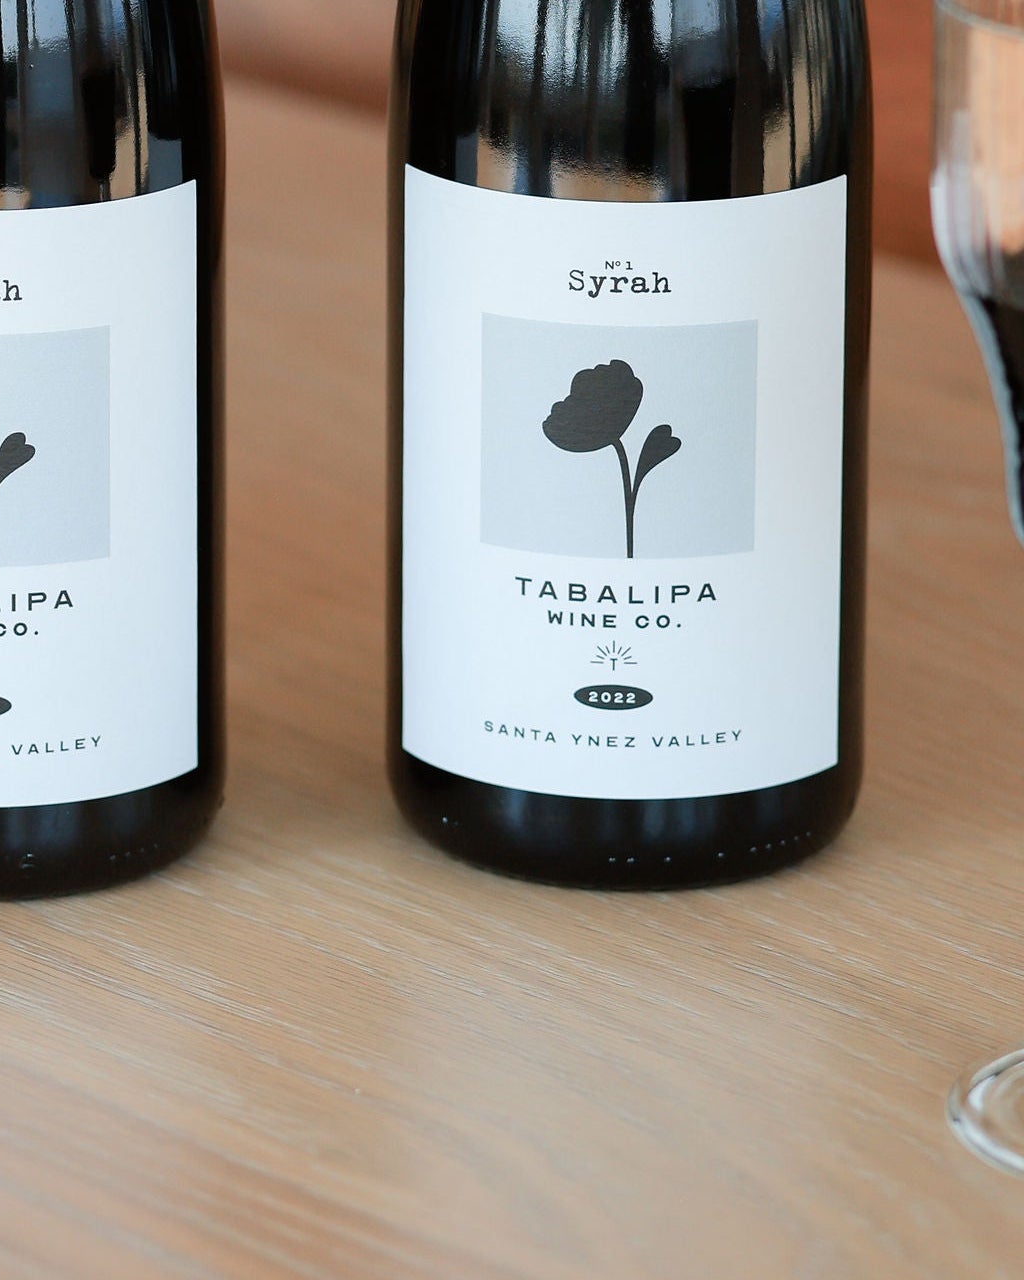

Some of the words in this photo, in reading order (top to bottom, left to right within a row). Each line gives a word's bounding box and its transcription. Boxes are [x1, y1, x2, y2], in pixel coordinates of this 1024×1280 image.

[568, 268, 672, 299] Syrah
[514, 576, 717, 605] TABALIPA
[547, 609, 617, 629] WINE
[634, 614, 682, 629] CO.
[588, 690, 637, 705] 2022
[11, 735, 101, 756] VALLEY
[484, 720, 557, 744] SANTA
[571, 734, 636, 748] YNEZ
[651, 729, 742, 748] VALLEY
